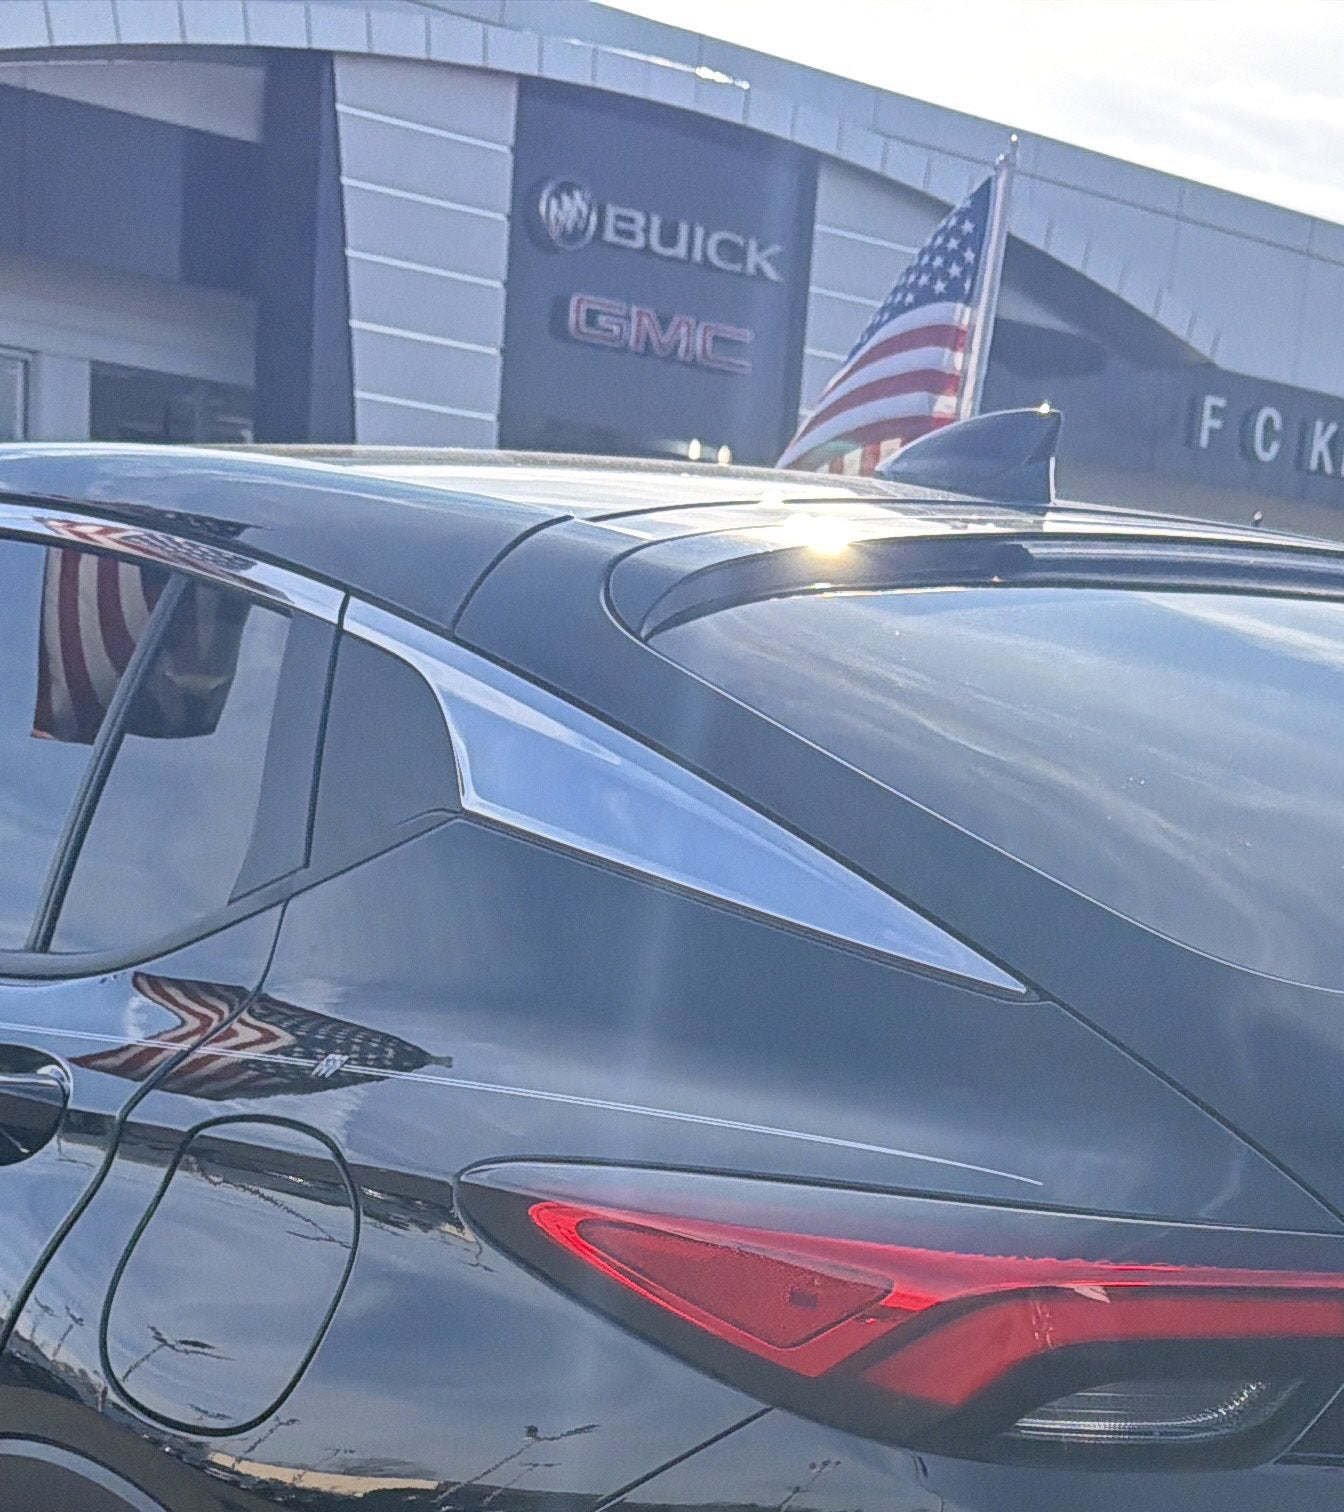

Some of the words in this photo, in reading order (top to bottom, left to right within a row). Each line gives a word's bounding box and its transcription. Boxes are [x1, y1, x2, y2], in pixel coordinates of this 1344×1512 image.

[602, 203, 786, 283] BUICK
[568, 292, 756, 376] GMC
[1198, 395, 1227, 449] F
[1253, 406, 1283, 462] C
